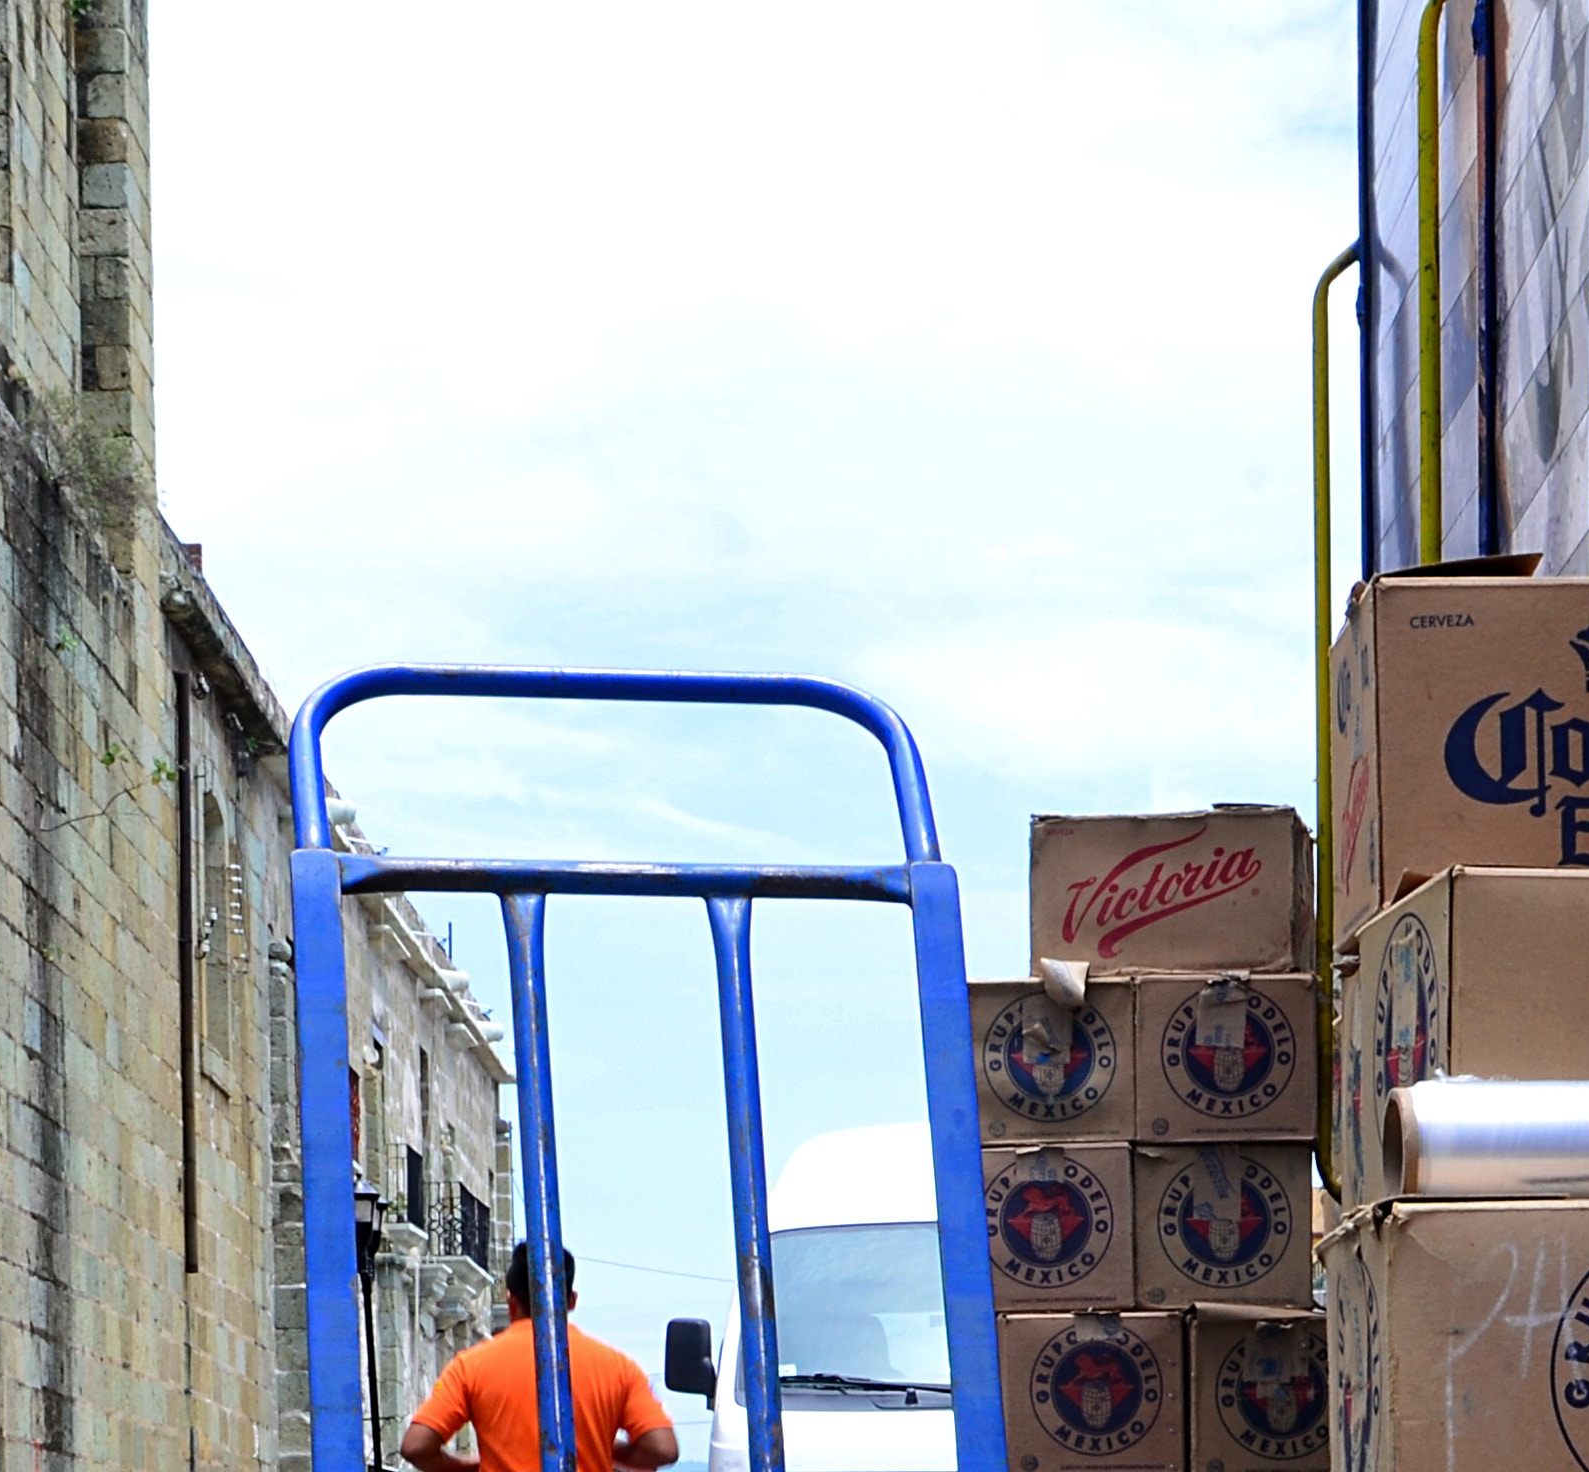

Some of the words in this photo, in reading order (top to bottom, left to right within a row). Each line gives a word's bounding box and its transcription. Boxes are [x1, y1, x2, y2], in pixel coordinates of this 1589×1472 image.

[1410, 613, 1475, 630] CERVEZA
[1062, 823, 1262, 959] Victoria
[989, 1003, 1023, 1072] GRUP
[1166, 1005, 1195, 1068] GRUP
[1246, 995, 1291, 1066] ODELO
[1009, 1087, 1098, 1119] MEXICO
[1186, 1083, 1278, 1116] MEXICO
[987, 1175, 1013, 1238] GRUP
[1064, 1164, 1109, 1235] ODELO
[1163, 1174, 1192, 1236] GRUP
[1244, 1164, 1288, 1236] ODELO
[1004, 1250, 1095, 1284] MEXICO
[1182, 1253, 1273, 1285] MEXICO
[1117, 1330, 1159, 1403] ODELO
[1055, 1420, 1145, 1452] MEXICO
